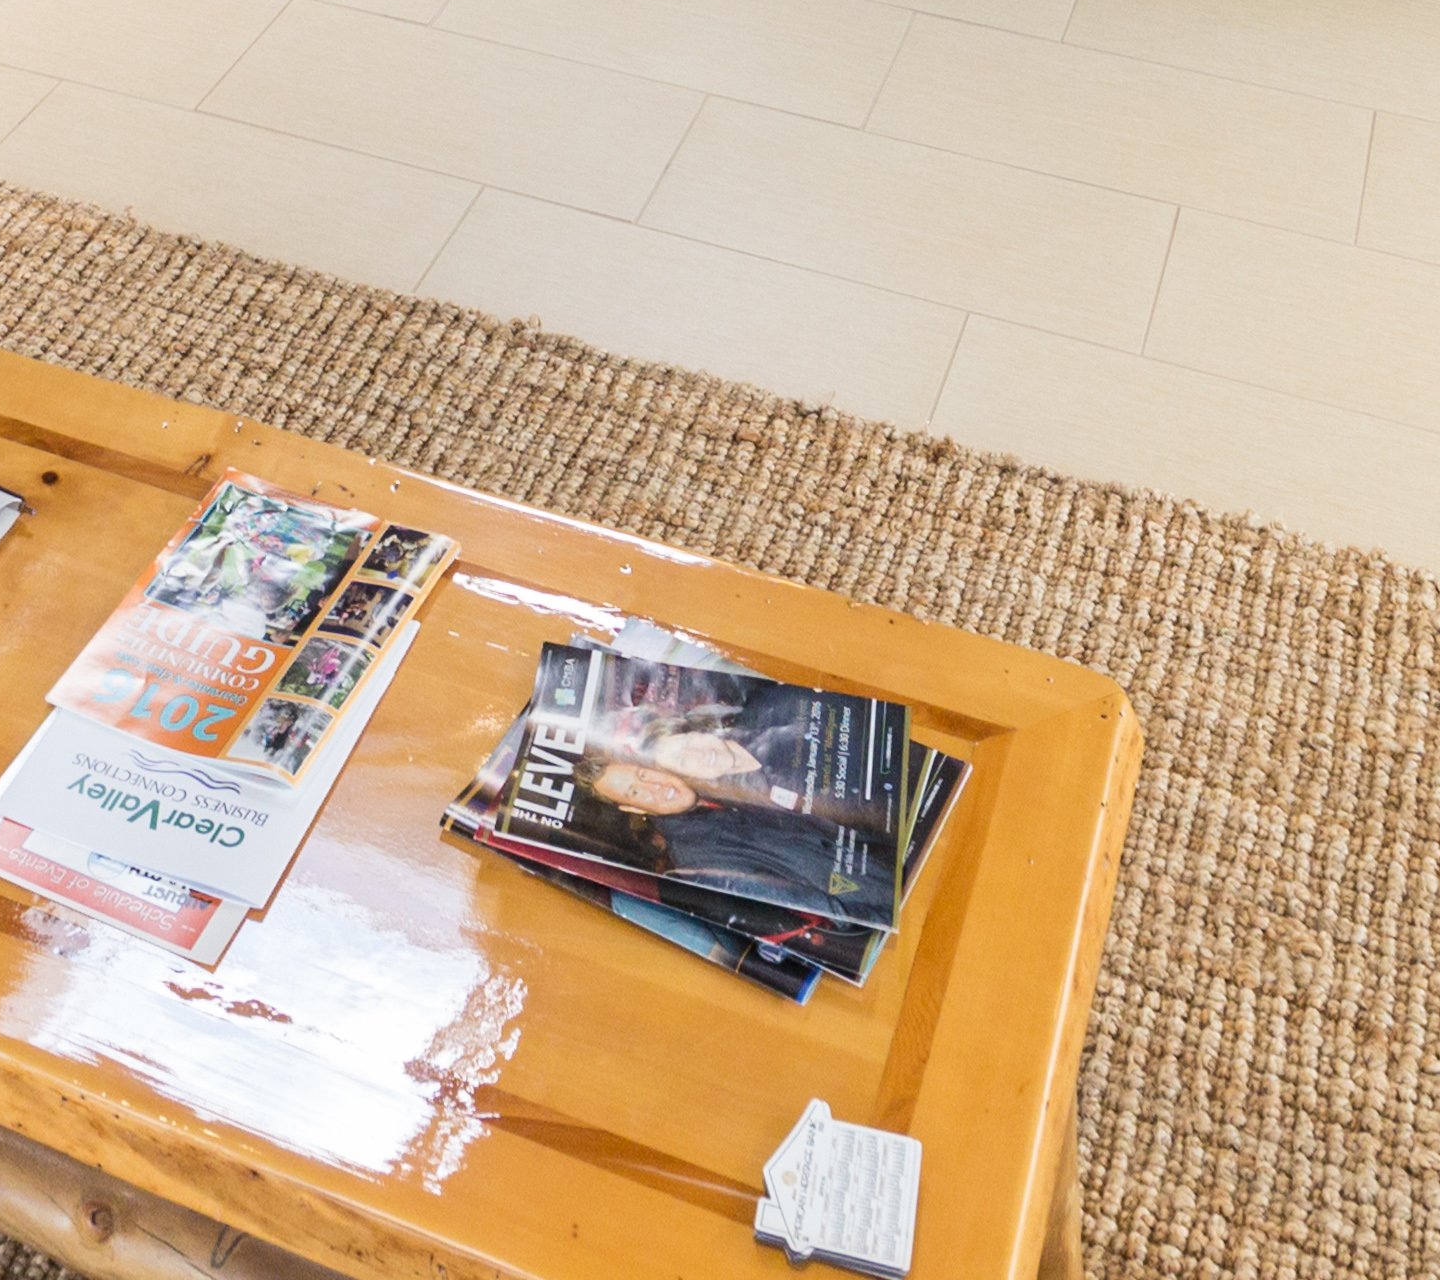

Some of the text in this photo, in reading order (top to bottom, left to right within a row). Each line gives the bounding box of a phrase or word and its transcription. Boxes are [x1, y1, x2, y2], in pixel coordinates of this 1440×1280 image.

[128, 604, 276, 674] GUIDE
[560, 657, 576, 687] CMBA
[93, 668, 237, 742] 2016
[67, 774, 246, 848] ClearValley
[72, 753, 270, 827] BUSINESS CONNECTIONS
[511, 808, 564, 829] ON THE
[66, 875, 90, 891] of
[93, 885, 177, 931] Schedule
